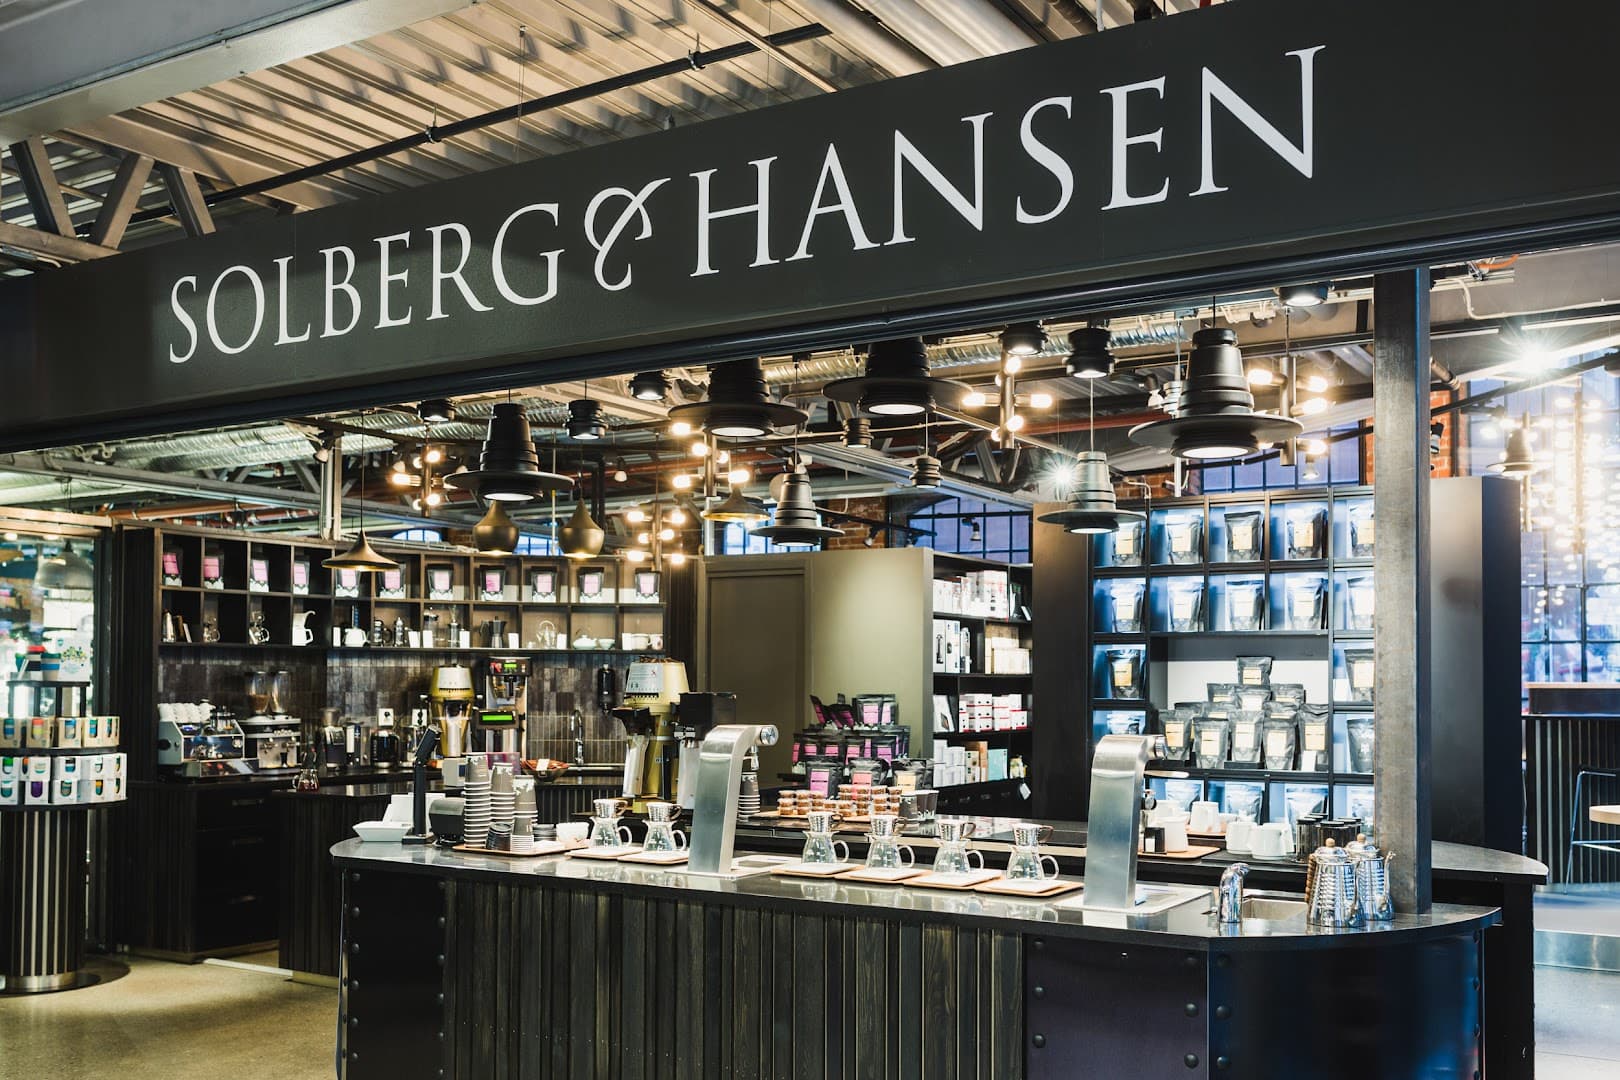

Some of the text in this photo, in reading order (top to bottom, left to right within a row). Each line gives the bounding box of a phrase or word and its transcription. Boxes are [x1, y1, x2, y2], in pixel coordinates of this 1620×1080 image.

[168, 44, 1326, 364] SOLBERG & HANSEN
